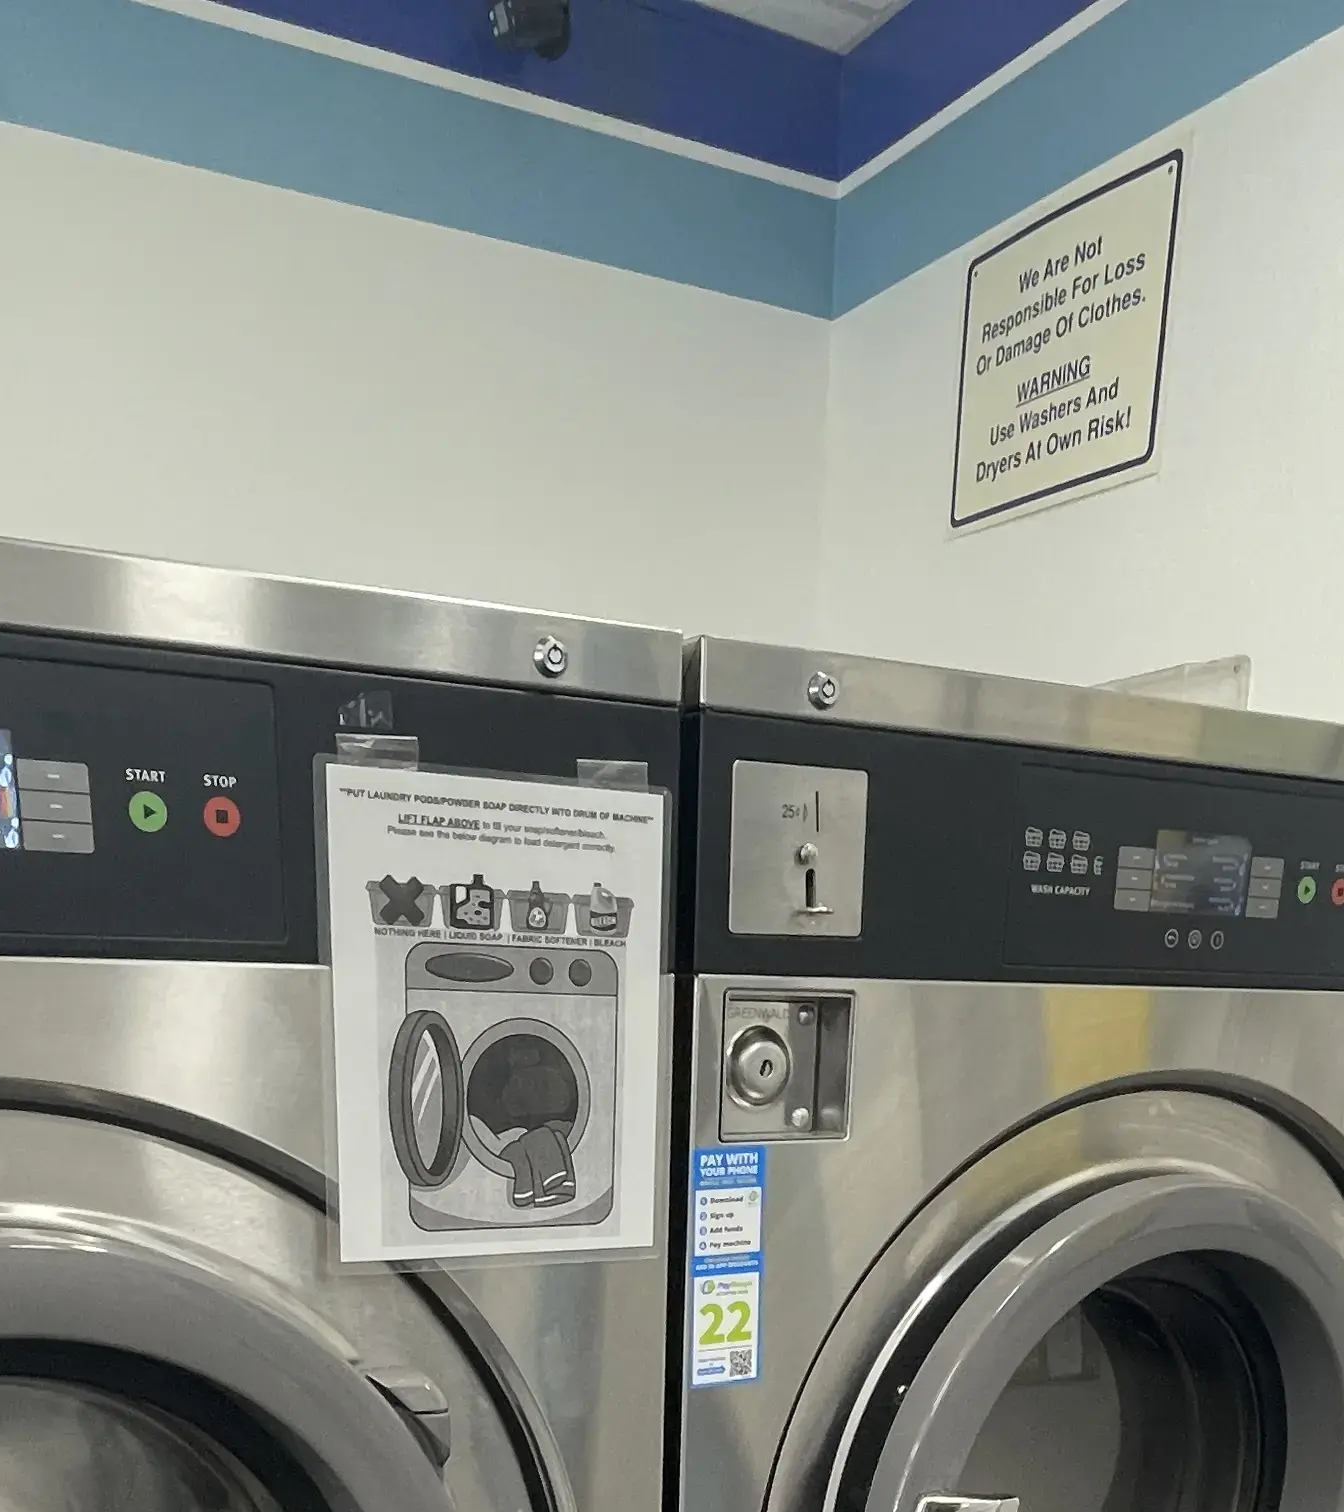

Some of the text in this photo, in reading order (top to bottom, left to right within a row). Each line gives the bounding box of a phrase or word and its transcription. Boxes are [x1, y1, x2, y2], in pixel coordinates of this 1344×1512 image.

[1019, 236, 1103, 293] We Are Not
[982, 252, 1145, 343] Responsible For Loss
[977, 287, 1146, 376] Or Damage Of Clothes.
[1017, 355, 1090, 403] WARNING
[990, 377, 1119, 447] Use Washers And
[976, 406, 1131, 484] Dryers At Own Risk!
[125, 767, 166, 783] START
[203, 773, 237, 788] STOP
[368, 790, 411, 803] LAUNDRY
[483, 801, 507, 811] SOAP
[509, 803, 550, 815] DIRECTLY
[552, 807, 571, 817] INTO
[573, 810, 597, 820] DRUM
[600, 812, 610, 820] OF
[398, 813, 418, 825] LIFT
[421, 815, 445, 827] FLAP
[447, 818, 480, 830] ABOVE
[1031, 883, 1091, 896] WASH CAPACITY
[374, 927, 416, 938] NOTHING
[512, 935, 542, 945] FABRIC
[594, 938, 627, 948] BLEACH
[700, 1152, 758, 1167] PAY WITH
[700, 1165, 758, 1177] YOUR PHONE
[699, 1301, 752, 1345] 22
